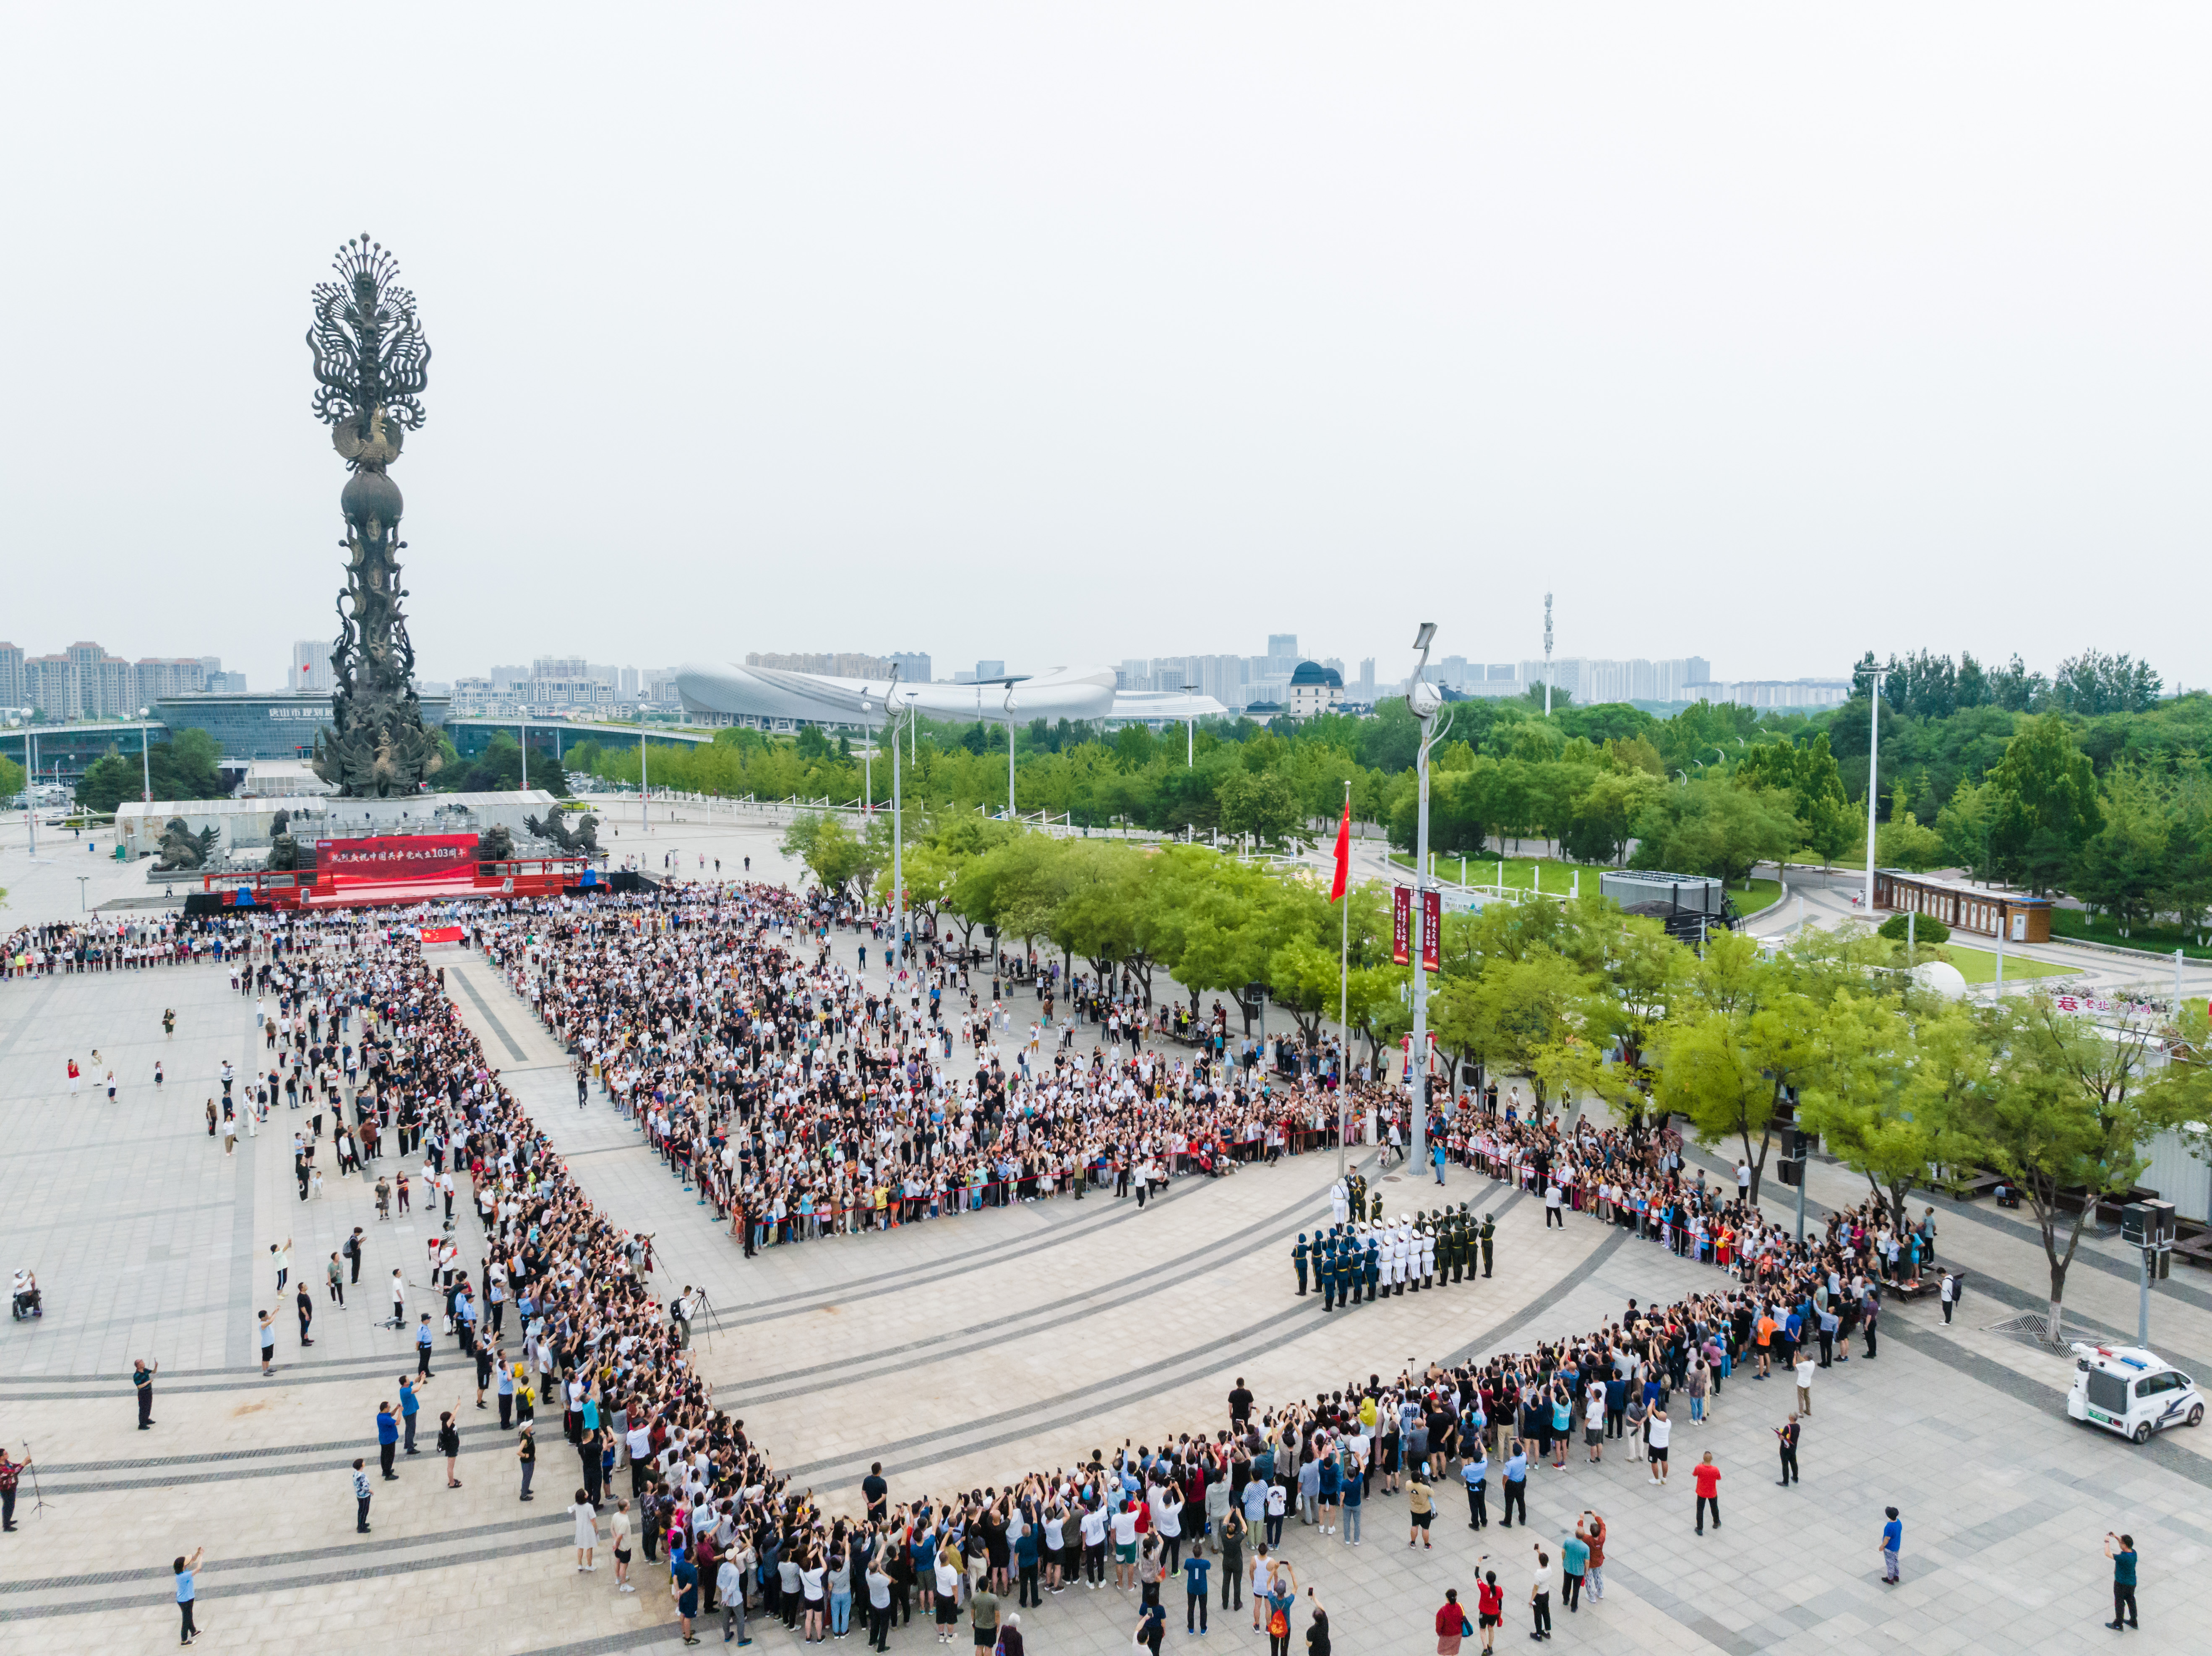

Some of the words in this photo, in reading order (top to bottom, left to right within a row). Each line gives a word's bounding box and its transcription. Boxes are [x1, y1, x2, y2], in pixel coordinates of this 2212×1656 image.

[332, 848, 466, 863] 热烈庆祝中国共产党成立103周年
